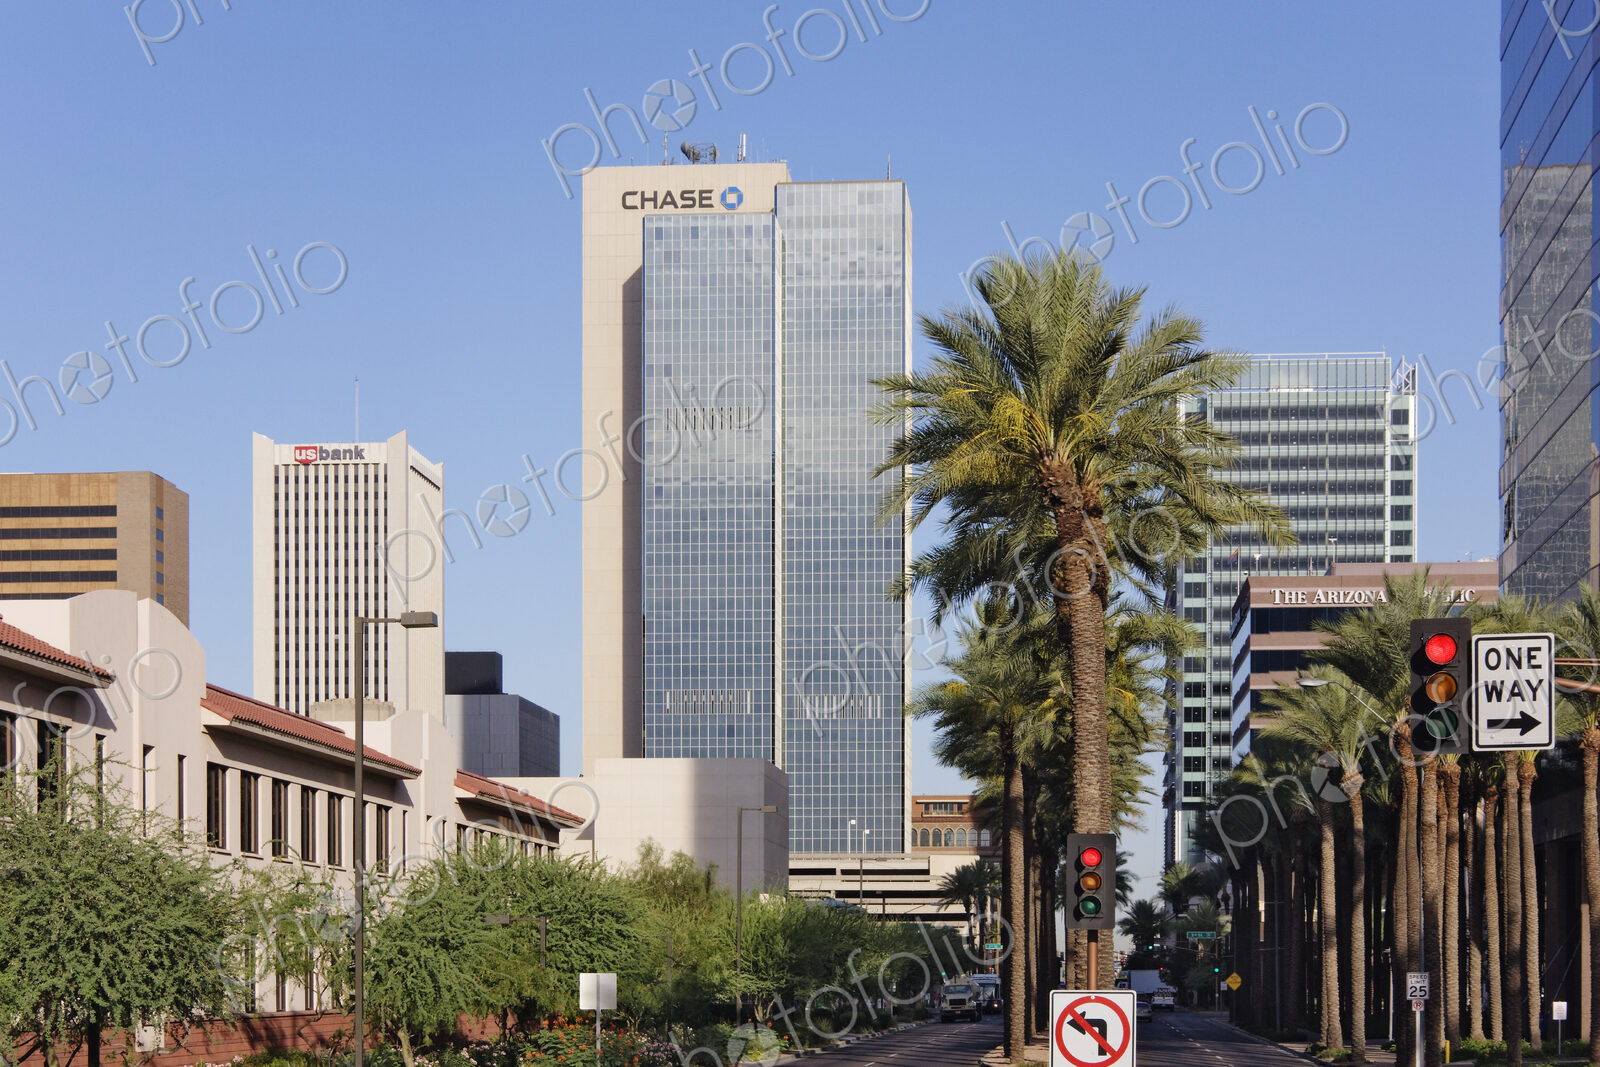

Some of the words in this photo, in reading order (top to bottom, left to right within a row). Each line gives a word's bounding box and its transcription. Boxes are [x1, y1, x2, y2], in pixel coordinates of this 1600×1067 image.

[621, 189, 715, 210] CHASE
[1270, 588, 1307, 604] THE
[1312, 588, 1388, 604] ARIZONA
[1484, 646, 1543, 671] ONE
[1484, 678, 1544, 703] WAY
[1409, 986, 1427, 997] 25
